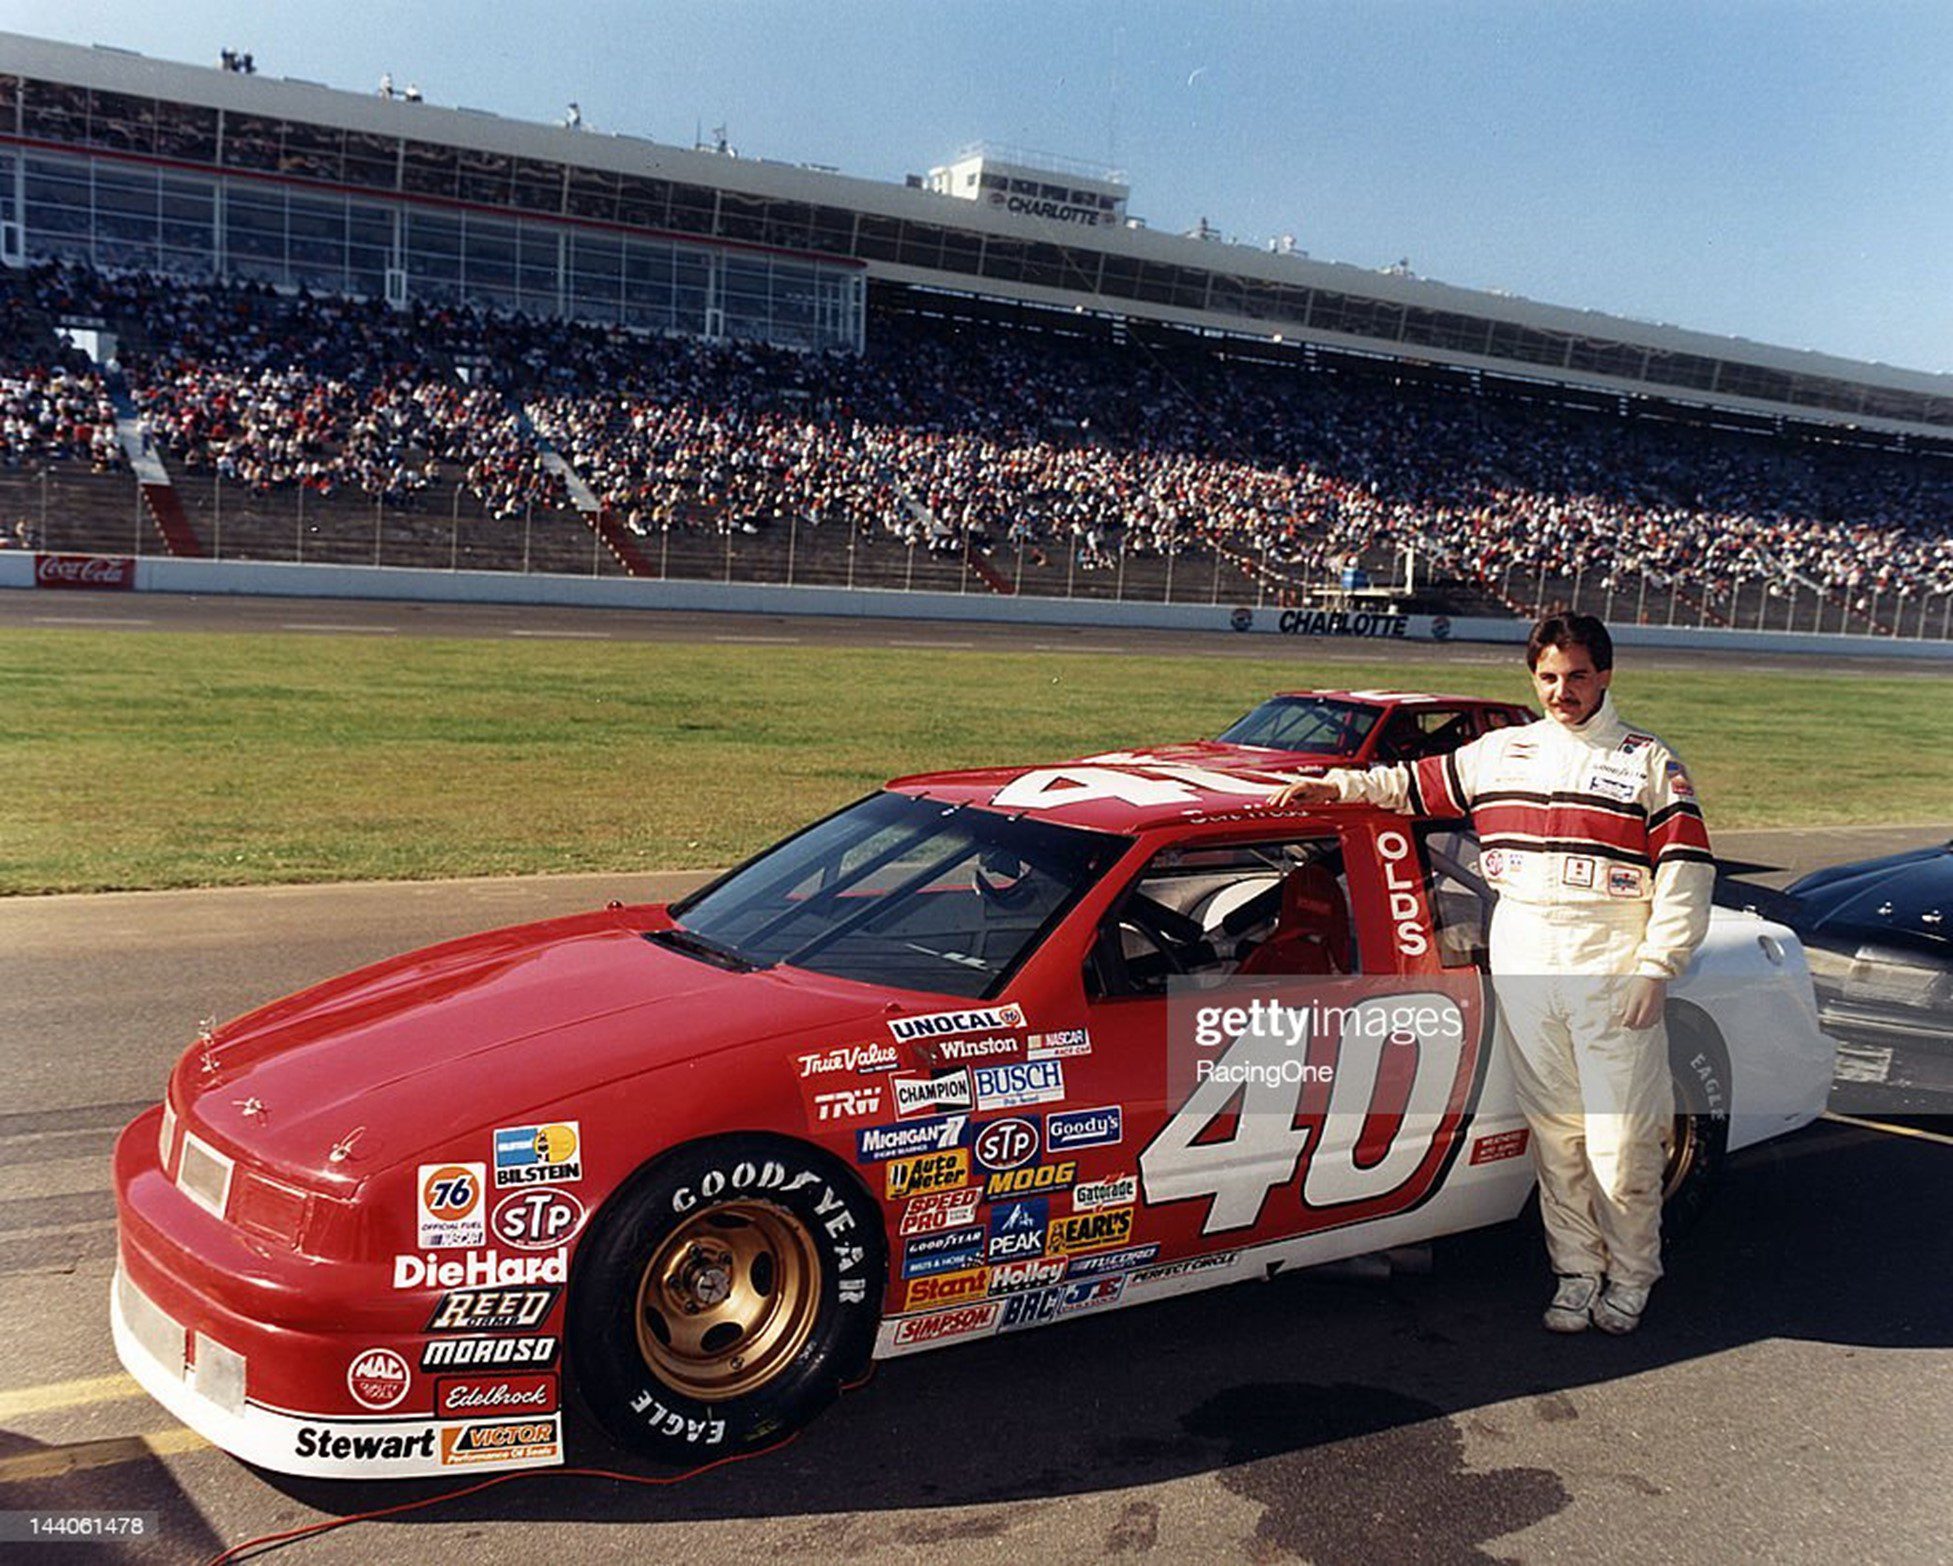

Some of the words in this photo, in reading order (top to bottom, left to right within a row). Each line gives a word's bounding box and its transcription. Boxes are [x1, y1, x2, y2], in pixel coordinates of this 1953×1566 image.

[1007, 197, 1100, 226] CHARLOTTE
[1279, 610, 1409, 637] CHARLOTTE
[1377, 831, 1427, 956] OLDS
[893, 1011, 1002, 1039] UNOCAL
[1045, 1029, 1084, 1047] NASCAR
[940, 1036, 1018, 1060] Winston
[899, 1080, 967, 1104] CHAMPION
[977, 1062, 1061, 1097] BUSCH
[1690, 1052, 1726, 1121] EAGLE
[815, 1087, 882, 1119] TRW
[1139, 993, 1463, 1234] 40
[936, 1115, 966, 1149] 77
[983, 1124, 1030, 1160] STP
[1050, 1114, 1119, 1142] Goody's
[497, 1163, 580, 1185] BILSTEIN
[912, 1155, 957, 1173] Auto
[987, 1162, 1076, 1194] MOOG
[433, 1178, 471, 1207] 76
[908, 1190, 977, 1215] SPEED
[1077, 1181, 1133, 1203] Gatorade
[503, 1195, 572, 1239] STP
[902, 1211, 947, 1233] PRO
[1066, 1209, 1132, 1241] EARL'S
[672, 1161, 866, 1304] GOODYEAR
[909, 1231, 981, 1252] GOODYEAR
[989, 1229, 1043, 1257] PEAK
[393, 1248, 568, 1288] DieHard
[991, 1262, 1064, 1289] Holley
[911, 1270, 988, 1302] Stant
[433, 1292, 551, 1328] REED
[902, 1303, 991, 1338] SIMPSON
[422, 1338, 556, 1366] MOROSO
[355, 1355, 403, 1380] MAC
[446, 1383, 547, 1409] Edelbrock
[631, 1390, 726, 1444] EAGLE
[295, 1427, 435, 1459] Stewart
[470, 1423, 552, 1448] VICTOR
